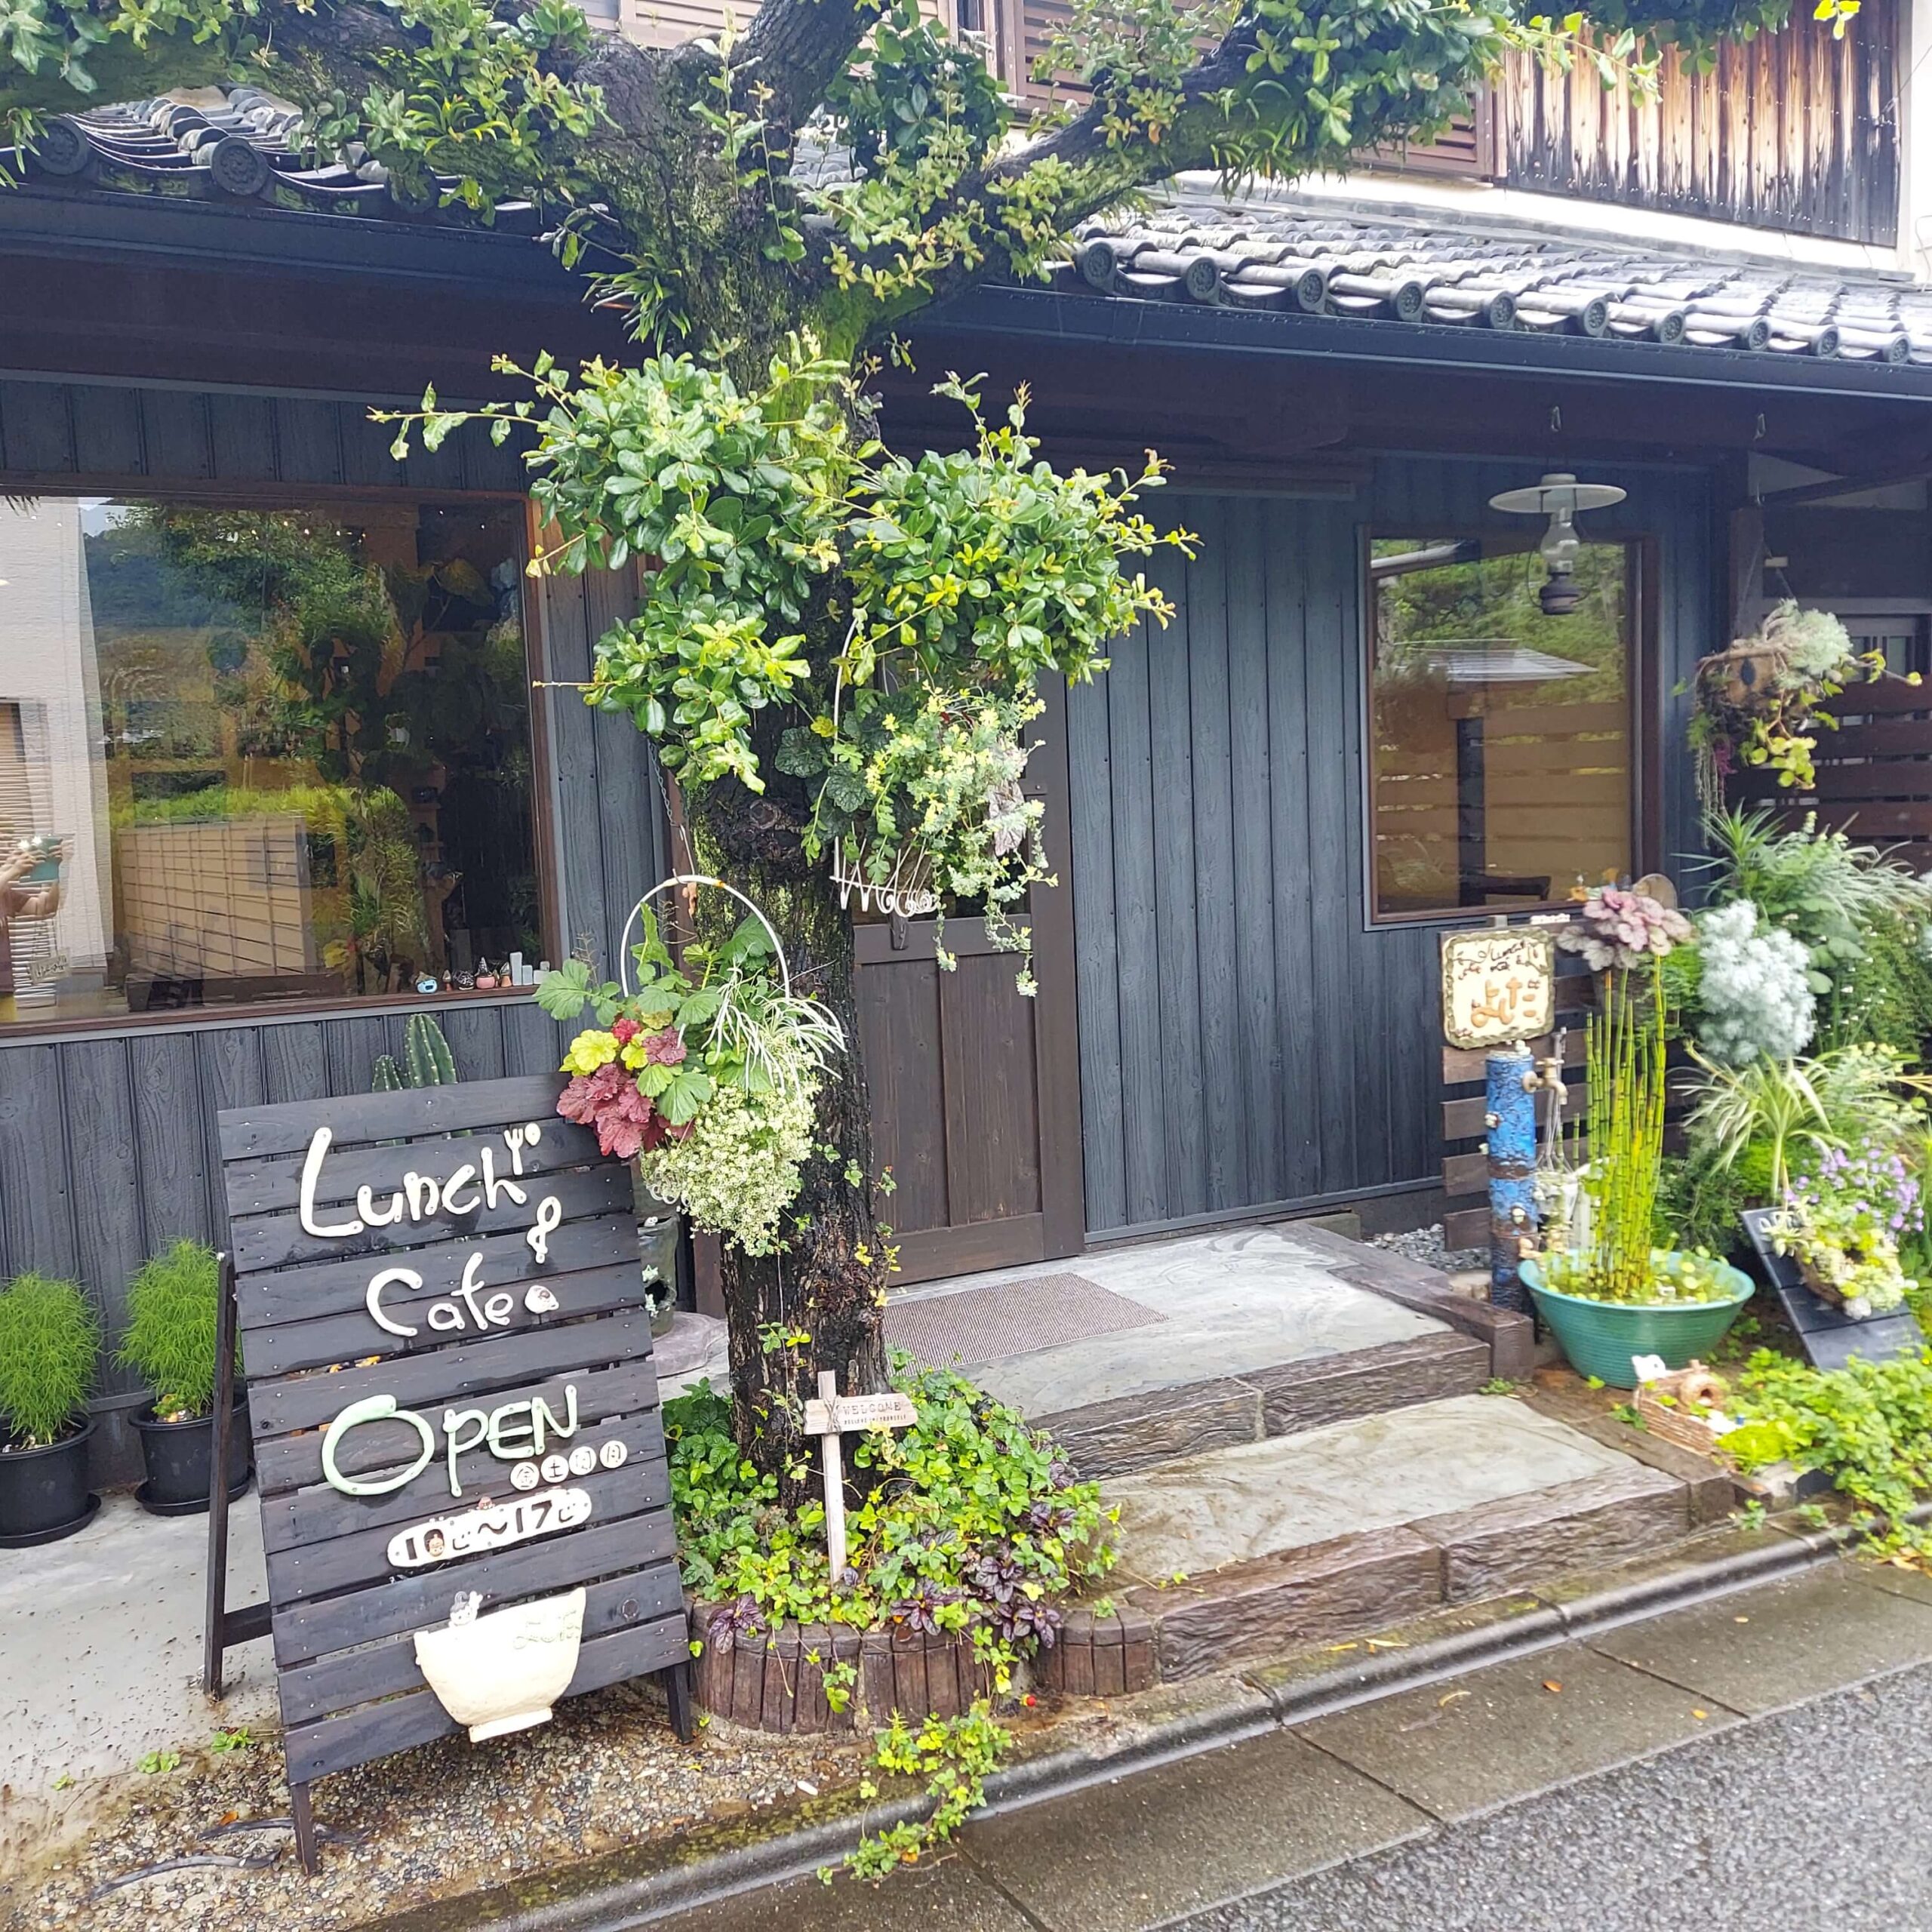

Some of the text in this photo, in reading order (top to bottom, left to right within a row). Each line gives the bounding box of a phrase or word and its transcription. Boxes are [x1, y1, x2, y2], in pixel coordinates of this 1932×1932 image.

[300, 1127, 527, 1238] Lunch
[366, 1251, 515, 1337] Cafe
[842, 1401, 902, 1416] WELCOME
